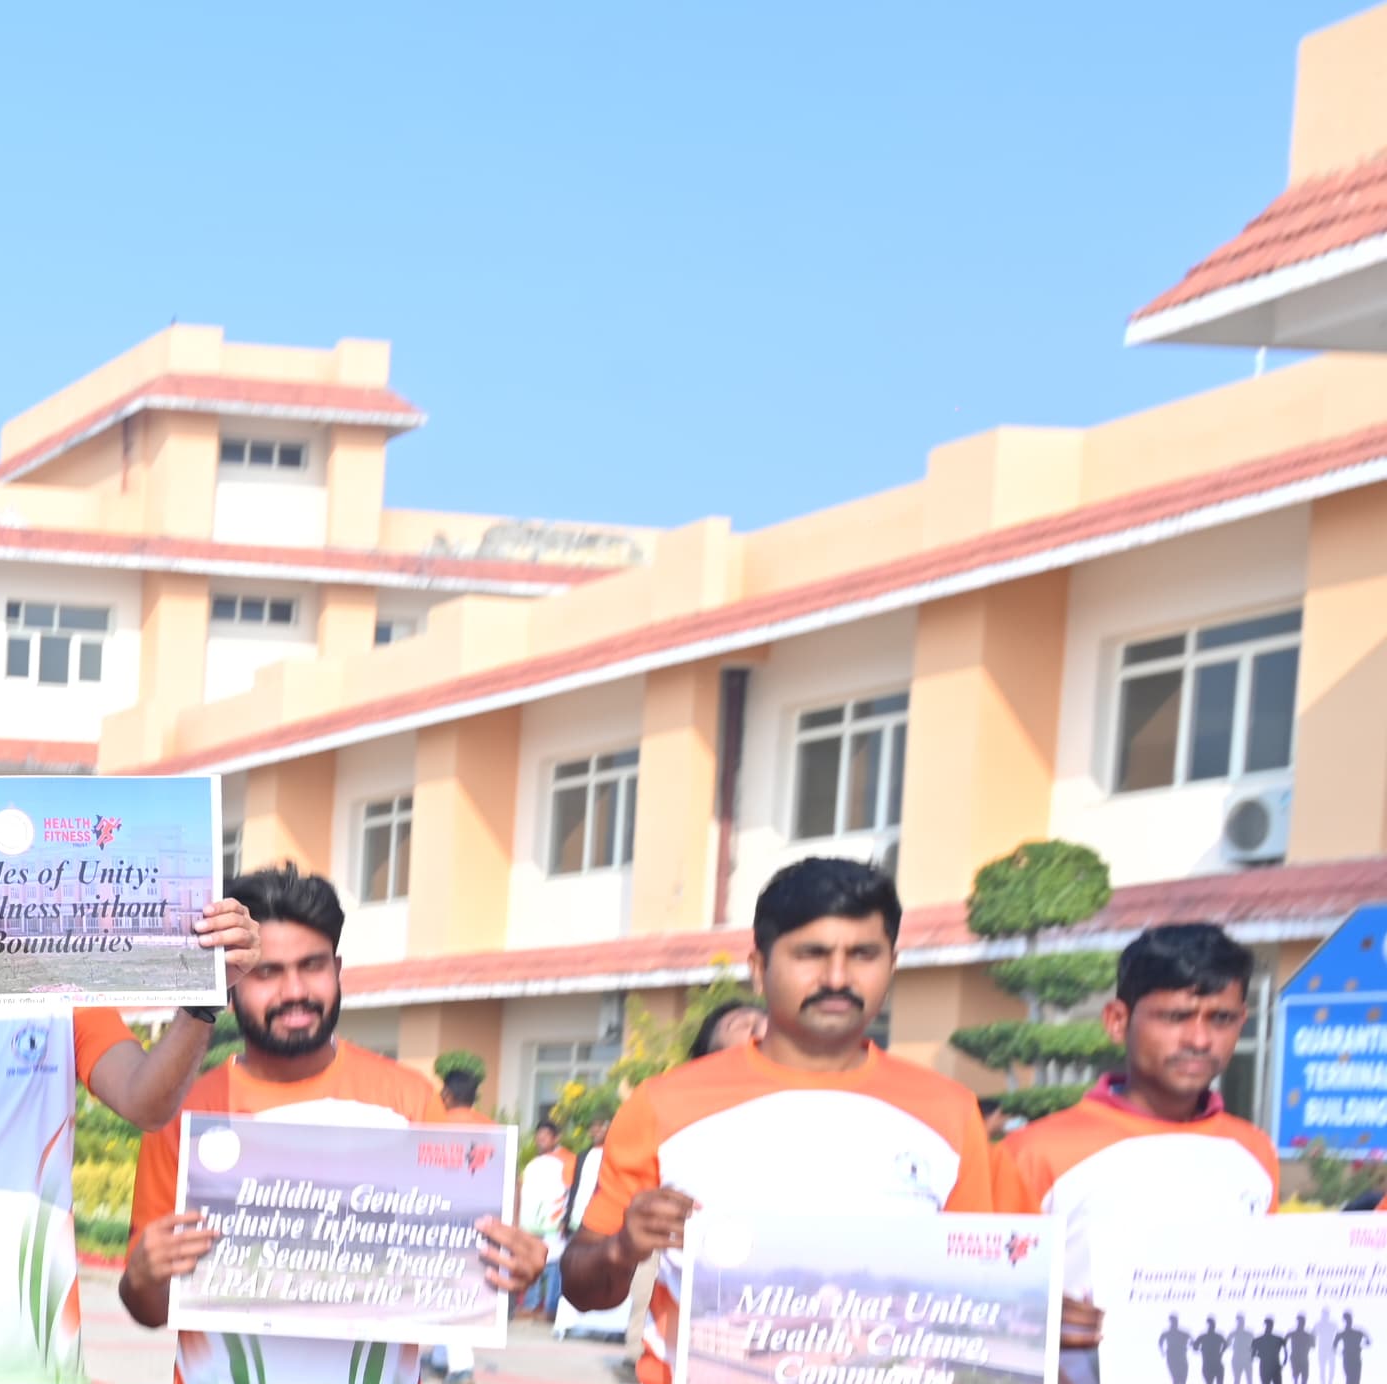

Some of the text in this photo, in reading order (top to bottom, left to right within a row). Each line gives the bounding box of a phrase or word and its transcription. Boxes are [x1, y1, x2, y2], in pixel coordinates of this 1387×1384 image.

[43, 817, 91, 829] HEALTH
[43, 830, 92, 843] FITNESS
[37, 859, 71, 891] of
[78, 859, 160, 890] Unity:
[71, 895, 169, 919] without
[236, 1177, 342, 1217] Building
[206, 1237, 251, 1276] for
[258, 1240, 375, 1274] Seamless
[201, 1270, 274, 1299] LPAI
[280, 1274, 354, 1304] Leads
[363, 1279, 403, 1307] the
[737, 1285, 819, 1317] Miles
[828, 1288, 892, 1321] that
[741, 1320, 990, 1363] Health, Culture,
